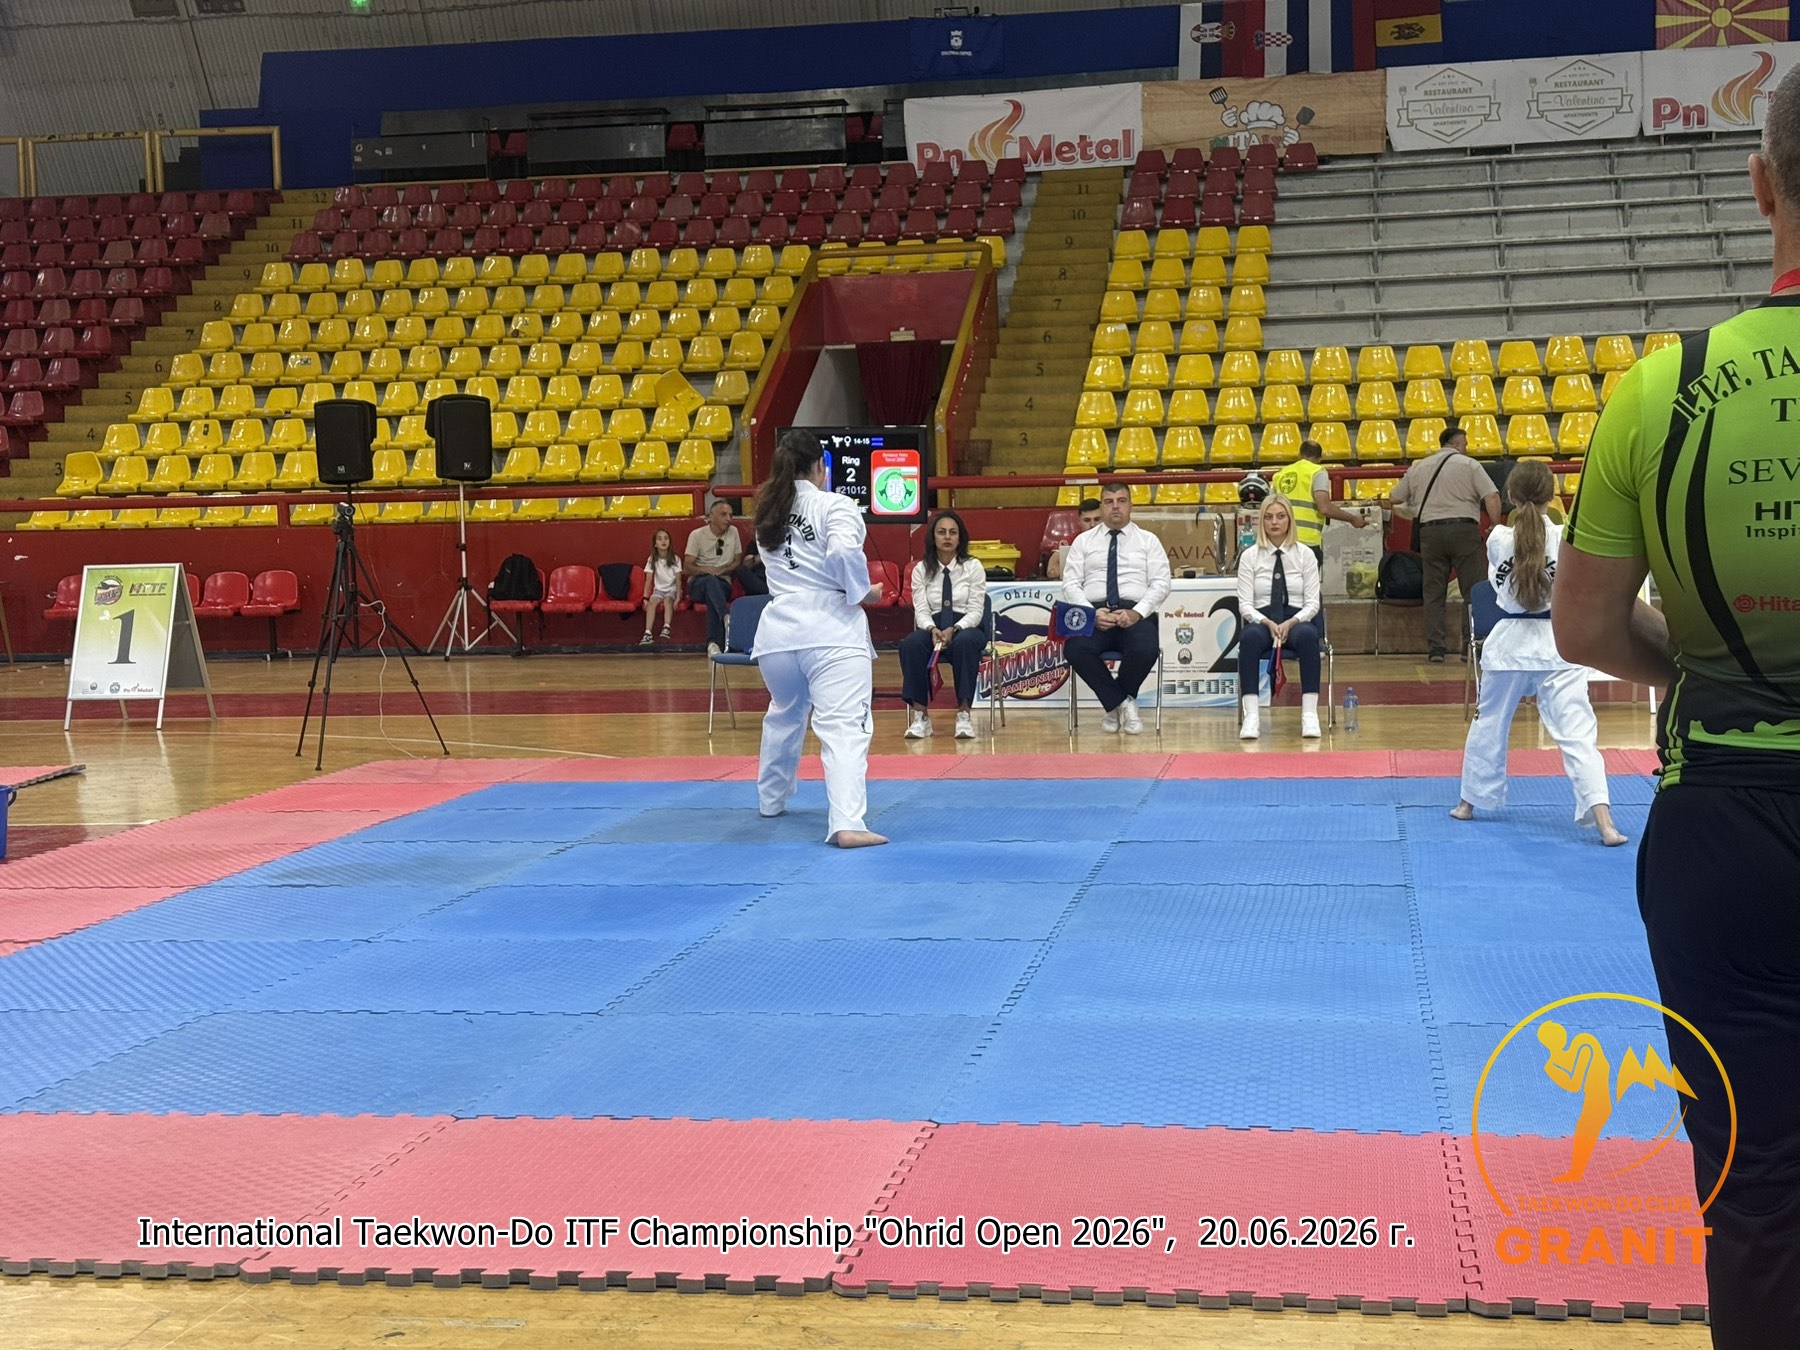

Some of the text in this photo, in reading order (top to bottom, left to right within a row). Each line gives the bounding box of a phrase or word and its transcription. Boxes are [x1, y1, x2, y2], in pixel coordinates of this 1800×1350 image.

[1554, 79, 1605, 88] RESTAURANT
[1423, 87, 1473, 96] RESTAURANT
[1553, 94, 1605, 107] Valentino
[1423, 102, 1474, 115] Valentino
[1652, 97, 1706, 129] Pn
[916, 129, 1134, 171] Pn Metal
[1078, 184, 1089, 194] 11
[315, 193, 327, 203] 12
[1072, 210, 1086, 220] 10
[291, 219, 303, 229] 11
[1065, 236, 1073, 248] 9
[265, 244, 279, 253] 10
[243, 269, 250, 280] 9
[1059, 268, 1067, 280] 8
[213, 301, 221, 312] 8
[1054, 299, 1062, 310] 7
[186, 330, 194, 341] 7
[1043, 331, 1051, 343] 6
[154, 361, 162, 373] 6
[1035, 363, 1044, 375] 5
[1671, 359, 1752, 424] I.T.F.
[124, 392, 133, 404] 5
[1025, 398, 1033, 410] 4
[87, 428, 95, 439] 4
[1019, 433, 1028, 446] 3
[853, 437, 870, 445] 14-15
[841, 456, 860, 466] Ring
[54, 463, 63, 476] 3
[845, 468, 856, 482] 2
[835, 485, 867, 495] #21012
[1755, 500, 1800, 521] HI
[1745, 524, 1800, 540] Inspi
[1004, 588, 1041, 601] Ohrid
[107, 608, 137, 665] 1
[1208, 595, 1242, 673] 2
